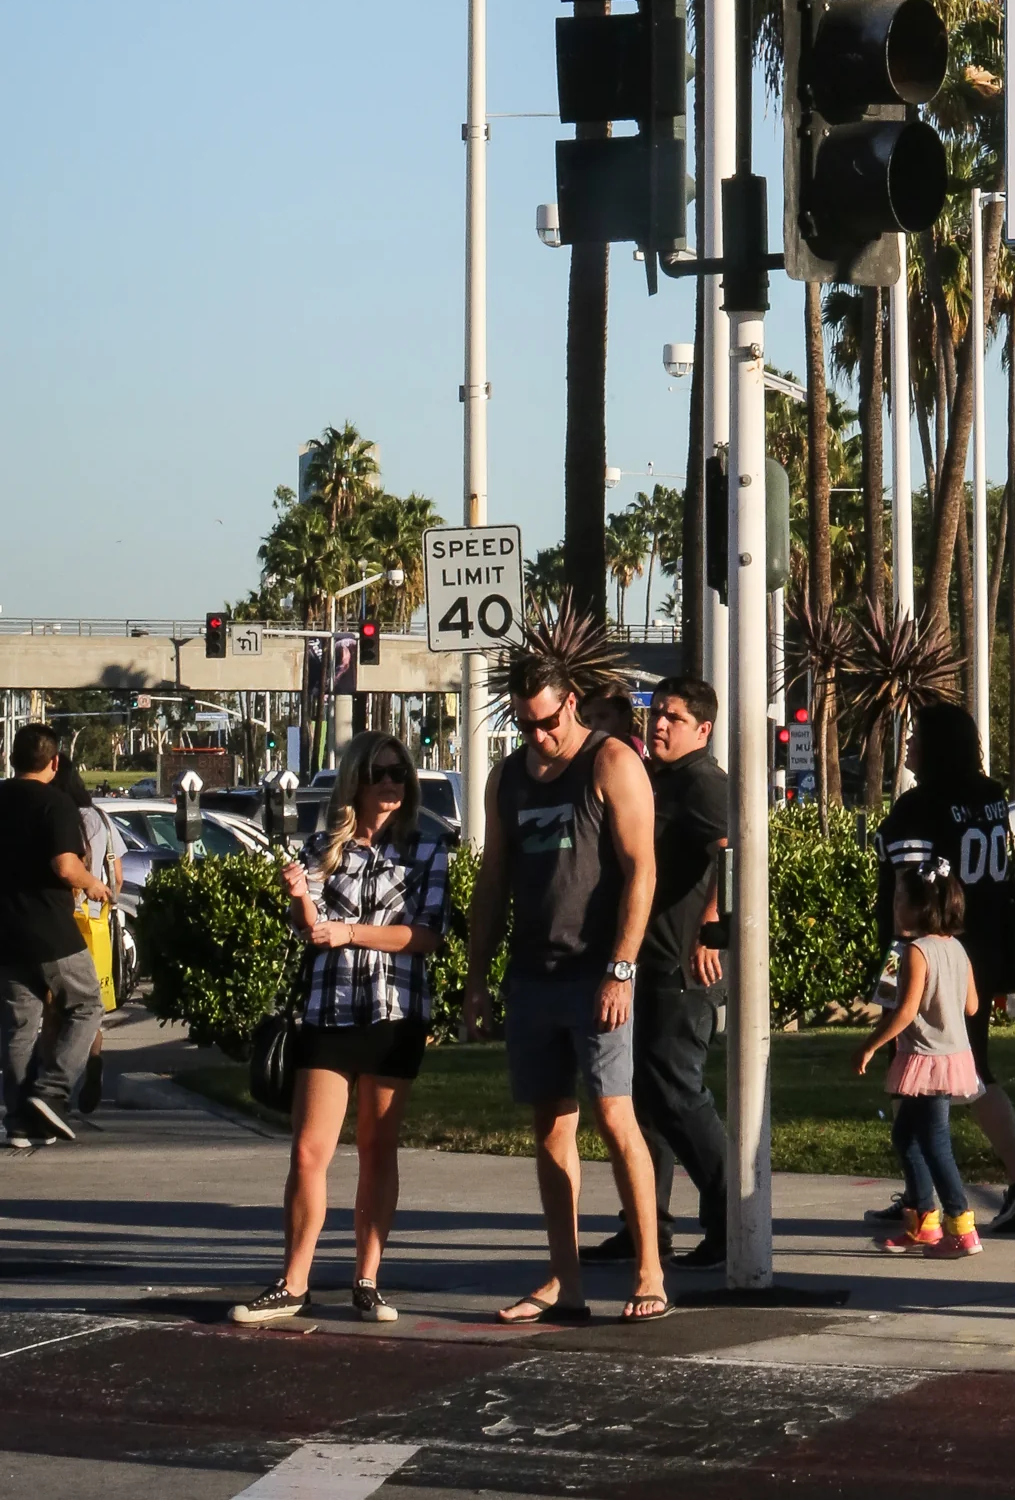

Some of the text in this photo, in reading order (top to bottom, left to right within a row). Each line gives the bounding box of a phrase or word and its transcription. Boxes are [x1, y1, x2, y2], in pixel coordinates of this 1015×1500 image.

[432, 538, 514, 559] SPEED
[442, 566, 505, 587] LIMIT
[438, 594, 513, 639] 40
[796, 743, 811, 752] MU
[960, 825, 1008, 885] 00
